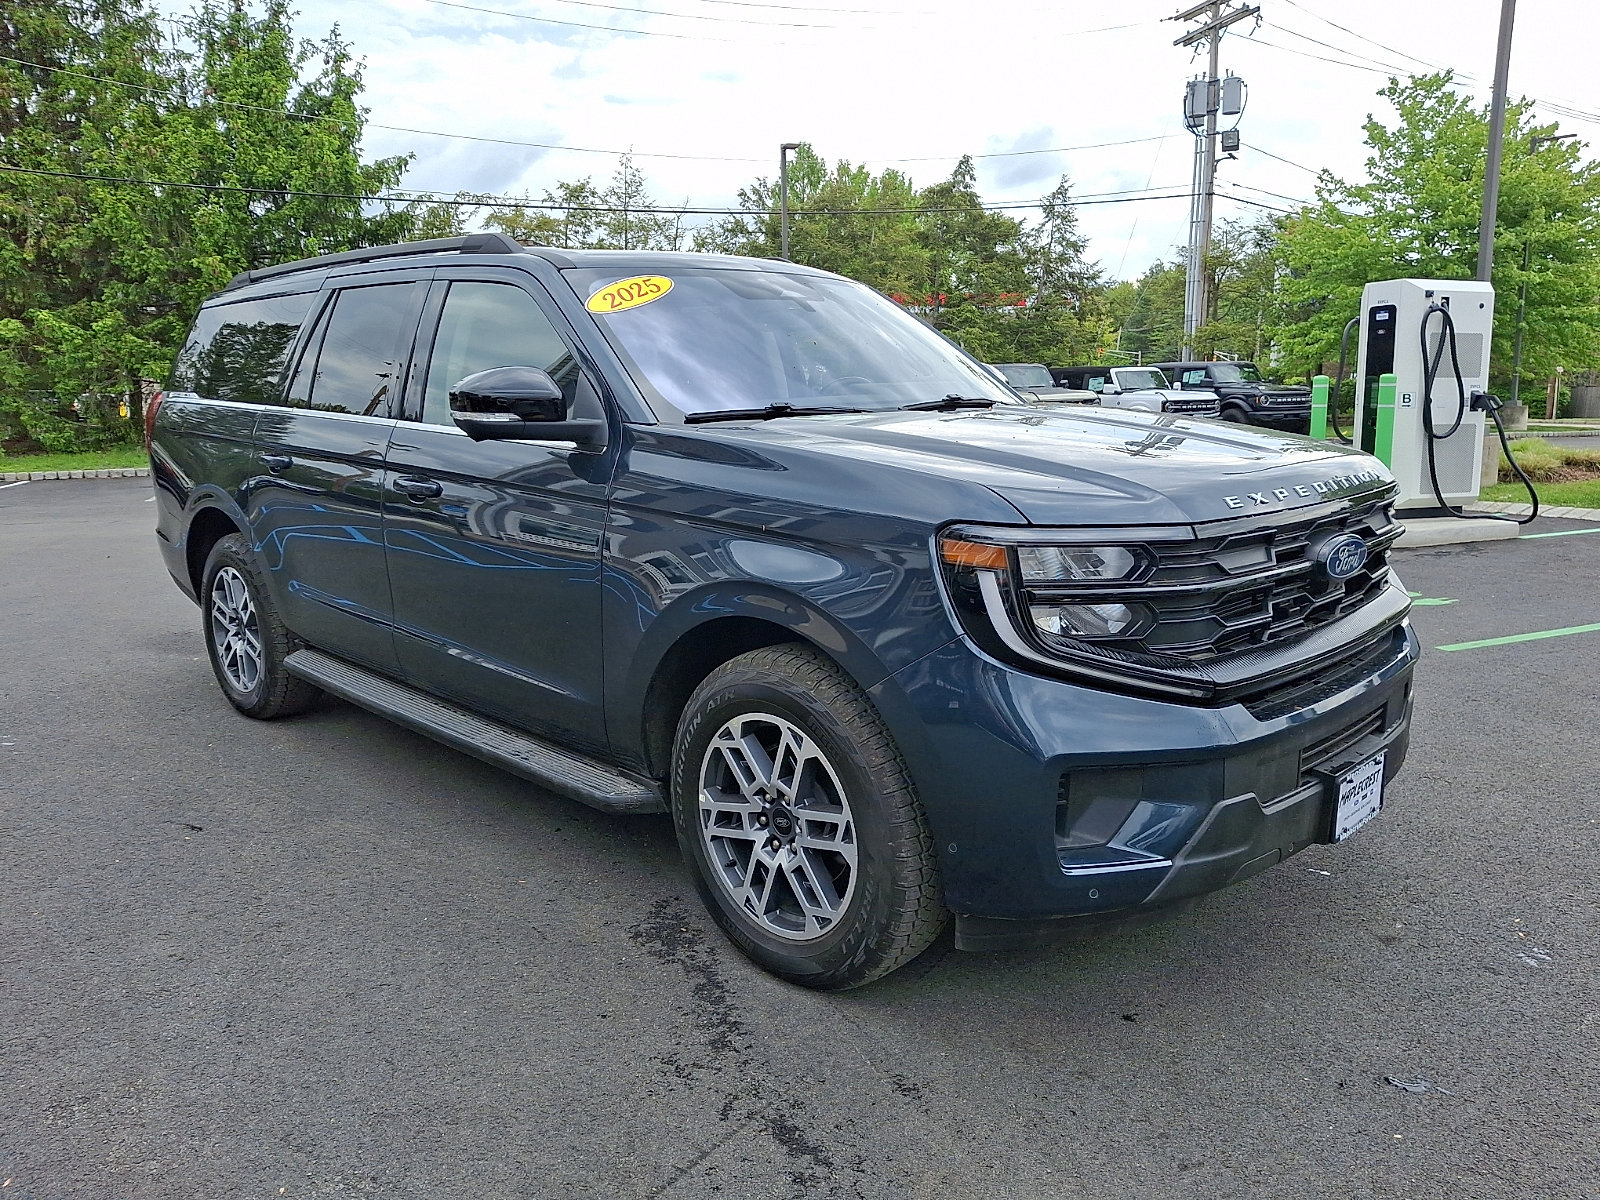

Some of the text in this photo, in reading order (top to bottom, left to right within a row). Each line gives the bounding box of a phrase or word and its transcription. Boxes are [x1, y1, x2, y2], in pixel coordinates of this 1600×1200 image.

[602, 278, 661, 309] 2025
[1402, 393, 1412, 404] B
[1223, 468, 1383, 510] EXPEDITION
[1333, 542, 1363, 577] Ford
